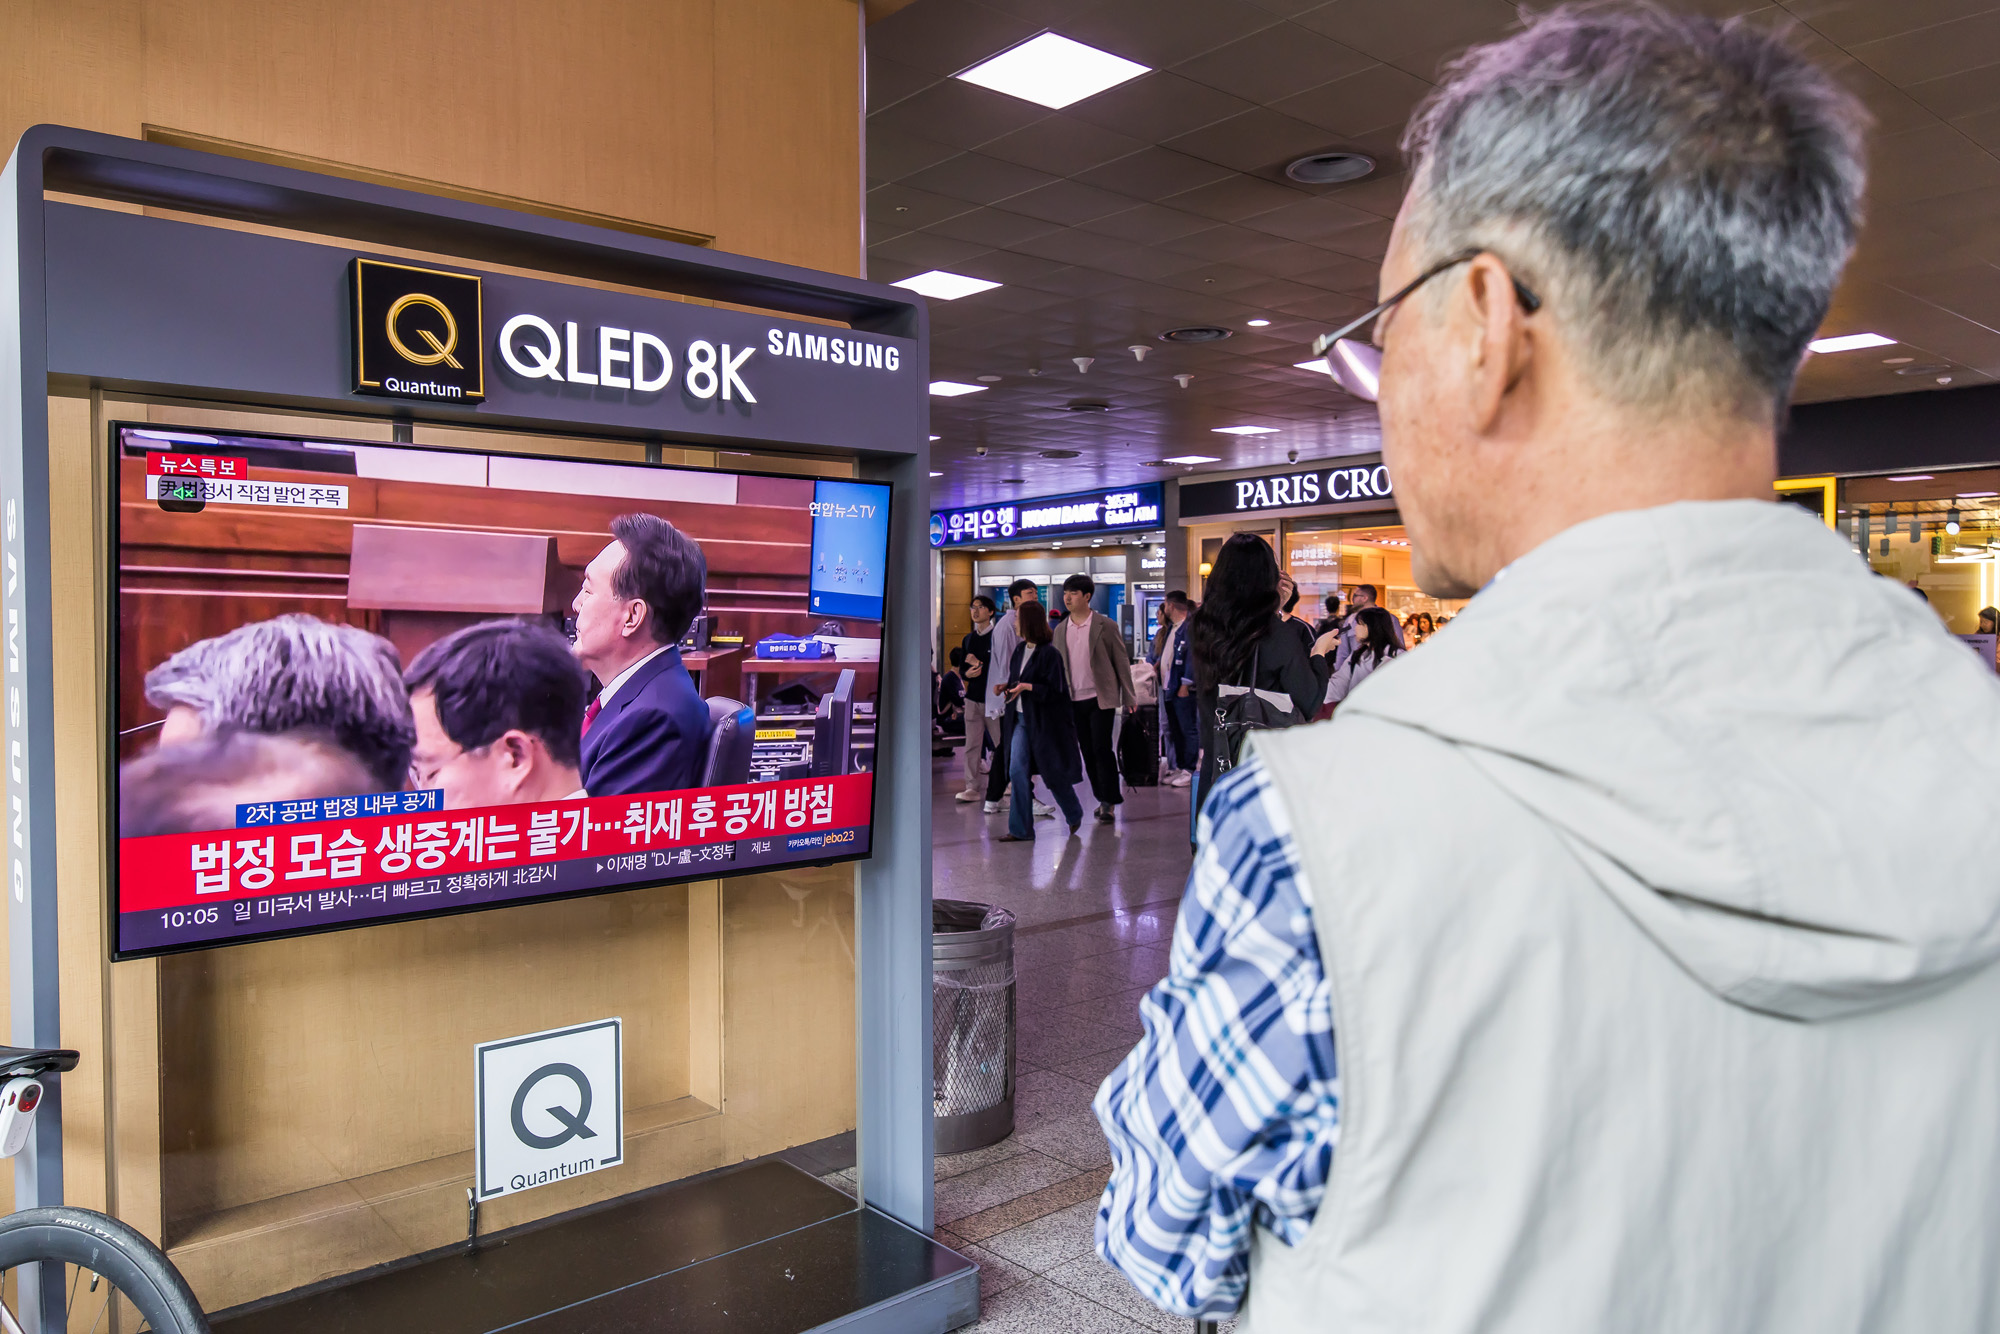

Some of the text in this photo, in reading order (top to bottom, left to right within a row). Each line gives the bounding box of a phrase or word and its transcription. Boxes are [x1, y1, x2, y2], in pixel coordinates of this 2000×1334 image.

[385, 293, 464, 371] Q
[500, 314, 758, 404] QLED 8K
[767, 328, 900, 372] SAMSUNG
[384, 377, 462, 399] Quantum
[159, 455, 237, 476] 뉴스특보
[237, 484, 270, 503] 직접
[273, 486, 306, 504] 발언
[308, 488, 341, 506] 주목
[1236, 473, 1320, 510] PARIS
[808, 501, 876, 519] 연합뉴스TV
[948, 507, 1016, 541] 우리은행
[1061, 502, 1100, 525] BANK
[1133, 505, 1157, 522] ATM
[7, 497, 24, 904] SAMSUNG
[246, 791, 435, 824] 2차 공판 법정 내부 공개
[191, 836, 275, 895] 법정
[284, 829, 367, 880] 모습
[374, 815, 520, 874] 생중계는
[688, 795, 717, 838] 후
[723, 789, 777, 835] 공개
[783, 784, 834, 828] 방침
[751, 841, 772, 855] 제보
[822, 830, 855, 847] jebo23
[607, 854, 647, 873] 이재명
[233, 901, 251, 921] 일
[258, 893, 312, 917] 미국서
[393, 880, 442, 900] 빠르고
[446, 870, 508, 894] 정확하게
[512, 864, 557, 885] 北감시
[161, 907, 219, 929] 10:05
[510, 1062, 598, 1150] Q
[510, 1157, 595, 1190] Quantum
[55, 1217, 93, 1231] PIRELLI
